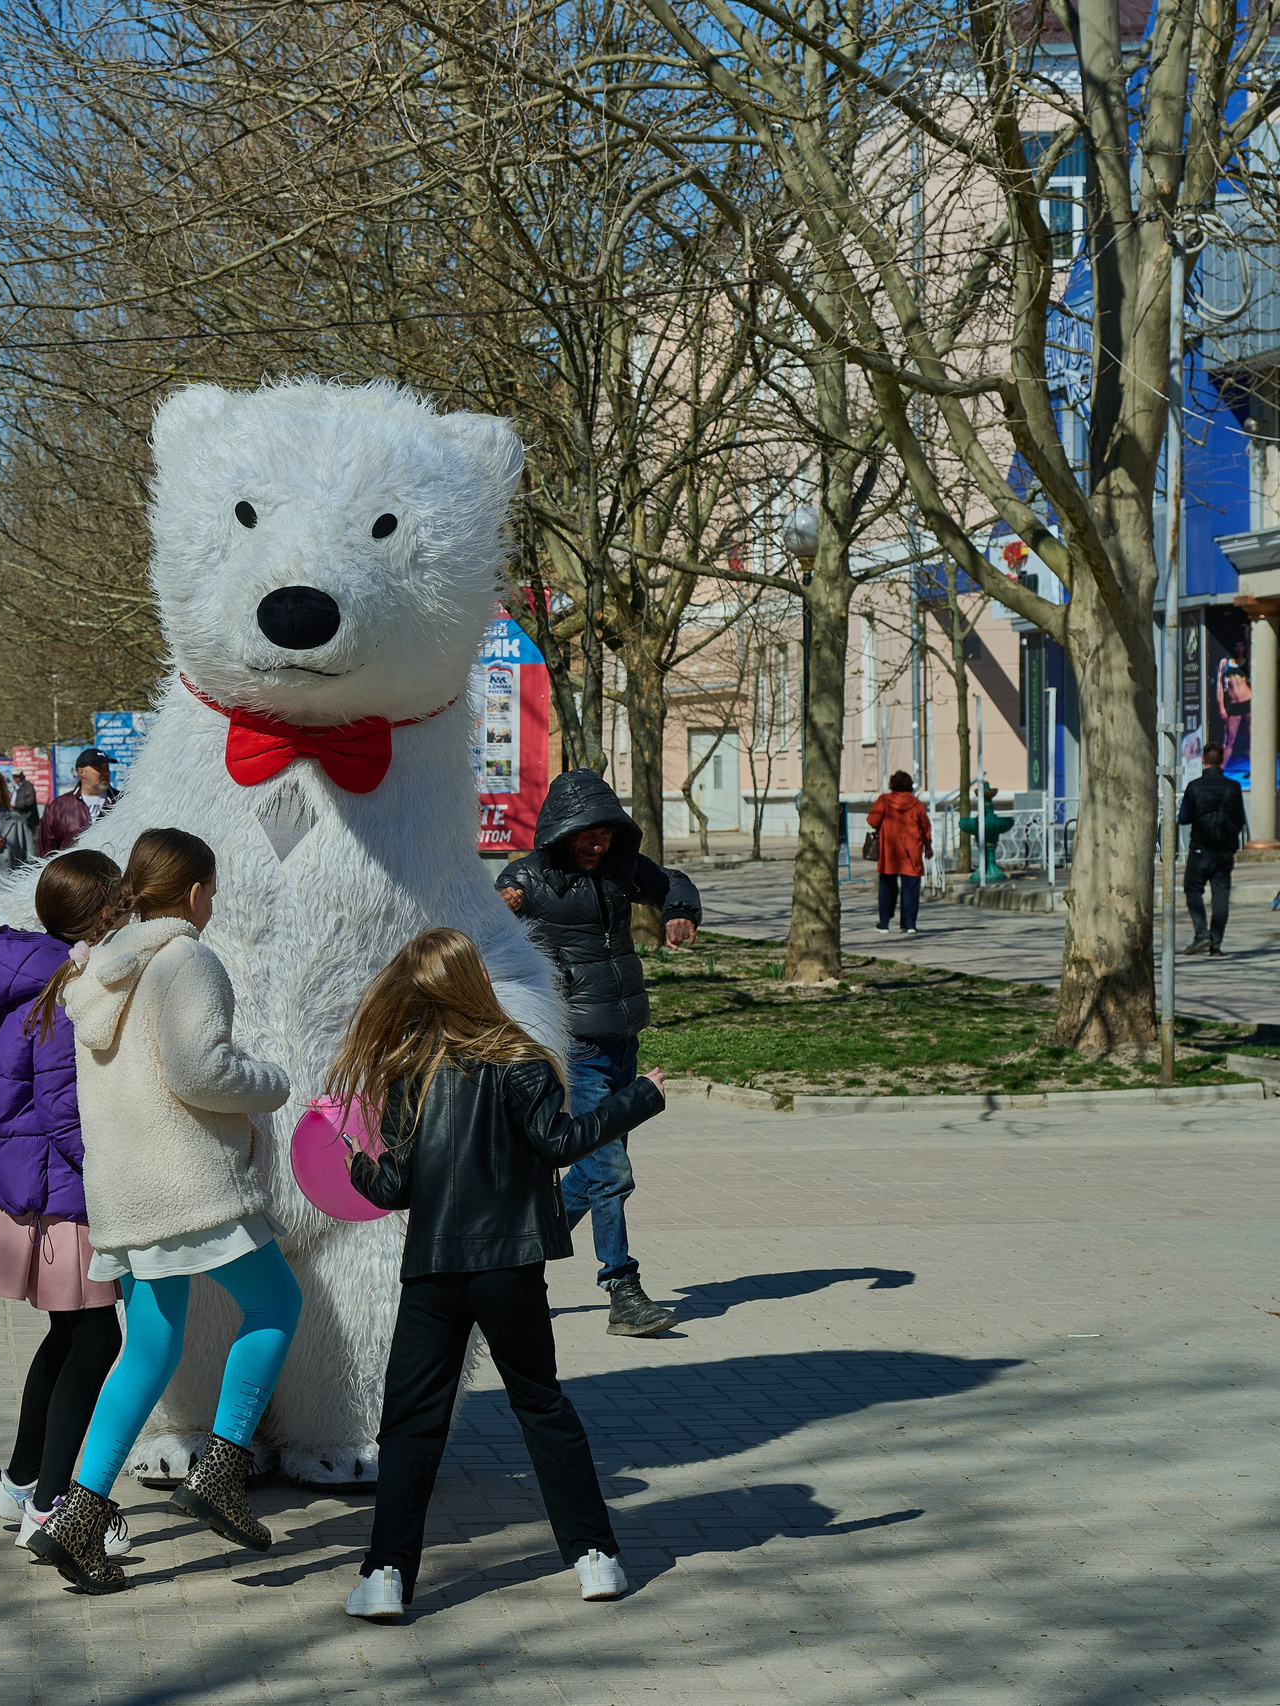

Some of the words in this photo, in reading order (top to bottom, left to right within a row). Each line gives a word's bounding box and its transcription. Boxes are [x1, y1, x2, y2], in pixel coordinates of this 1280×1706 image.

[253, 1387, 260, 1395] 1
[248, 1396, 258, 1406] 2
[244, 1408, 252, 1418] 3
[234, 1431, 242, 1440] 5
